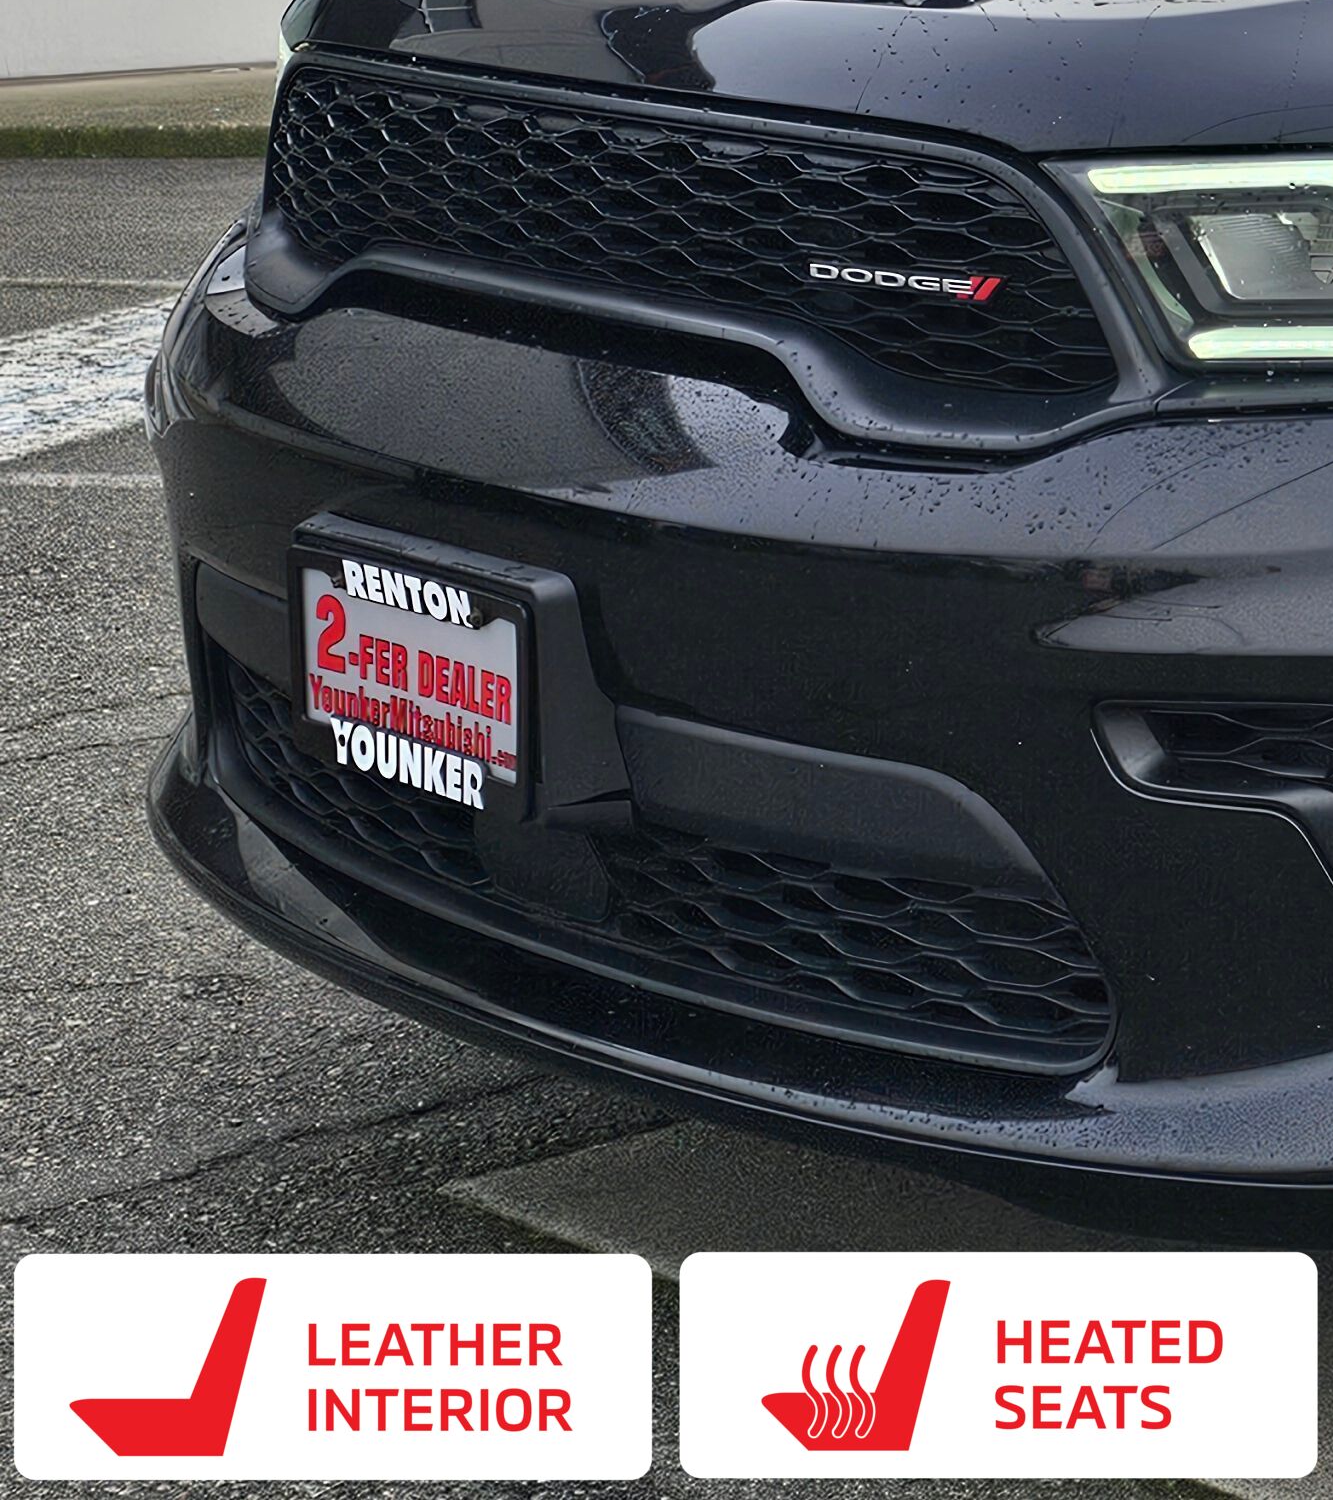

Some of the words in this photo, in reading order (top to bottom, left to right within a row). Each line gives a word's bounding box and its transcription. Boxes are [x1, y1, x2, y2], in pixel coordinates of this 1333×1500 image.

[809, 263, 974, 296] DODGE
[342, 559, 473, 628] RENTON
[316, 594, 409, 692] 2-FER
[418, 650, 512, 726] DEALER
[330, 716, 484, 810] YOUNKER
